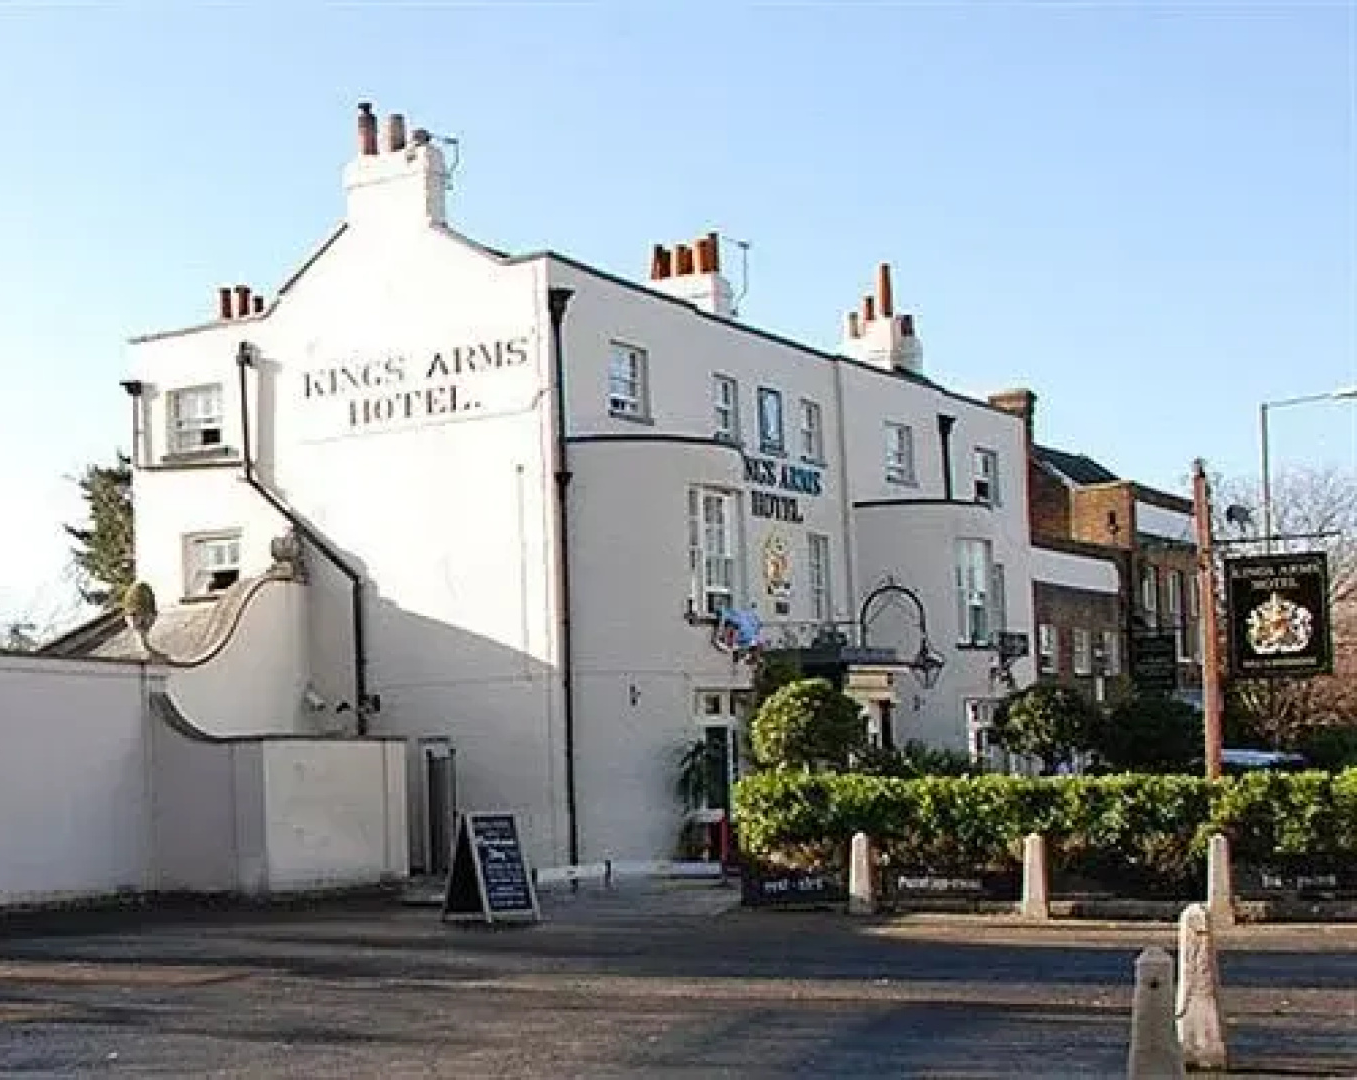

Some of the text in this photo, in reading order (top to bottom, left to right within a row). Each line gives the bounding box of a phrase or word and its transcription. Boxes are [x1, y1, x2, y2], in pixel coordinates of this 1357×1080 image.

[302, 335, 528, 399] KINGS ARMS
[744, 457, 822, 495] NGS ARMS
[752, 490, 804, 523] HOTEL
[1251, 578, 1300, 589] HOTEL
